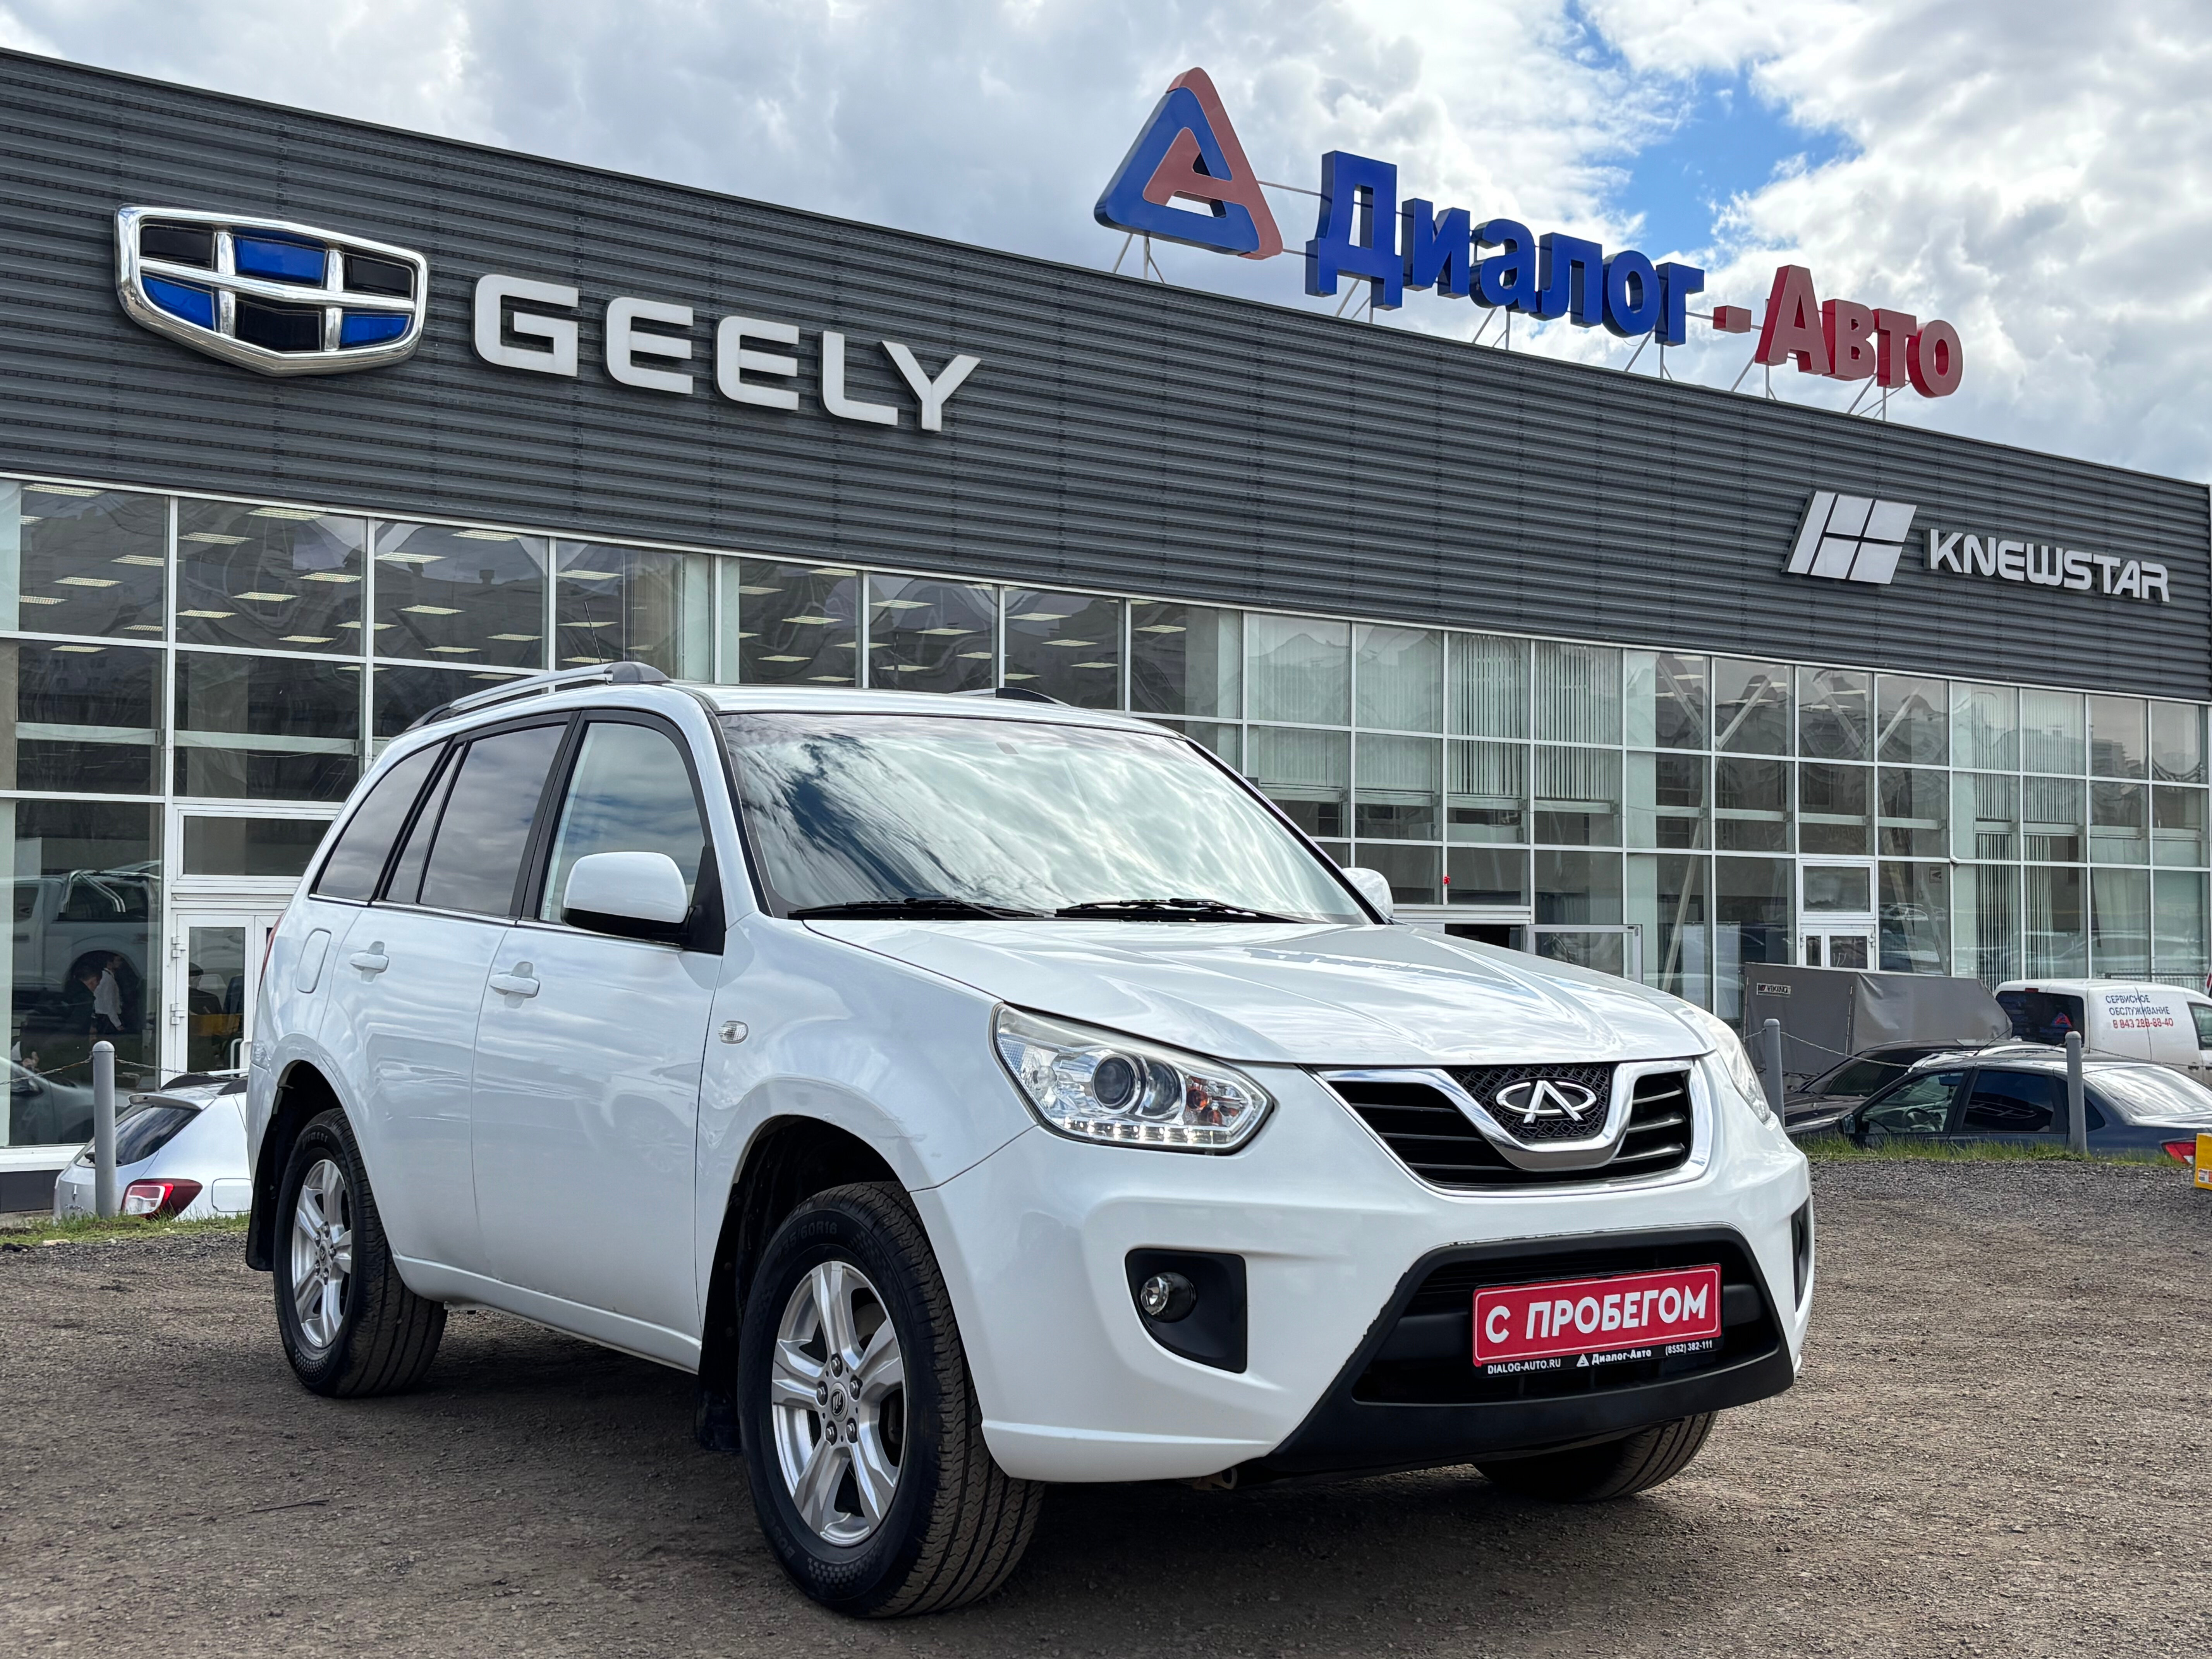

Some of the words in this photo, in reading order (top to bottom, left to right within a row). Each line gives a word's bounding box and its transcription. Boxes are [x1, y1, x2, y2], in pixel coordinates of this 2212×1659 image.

[473, 273, 981, 432] GEELY
[1928, 528, 2169, 602] KNEWSTAR
[2106, 995, 2150, 1003] СЕРВИСНОЕ
[2109, 1006, 2170, 1015] ОБСЛУЖИВАНИЕ
[2113, 1019, 2118, 1029] 8
[1484, 1305, 1510, 1344] С
[1525, 1283, 1708, 1339] ПРОБЕГОМ
[1666, 1344, 1686, 1356] (8552)
[1688, 1340, 1712, 1351] 382-111
[1592, 1349, 1652, 1365] Диалог-Авто
[1487, 1358, 1561, 1374] DIALOG-AUTO.RU
